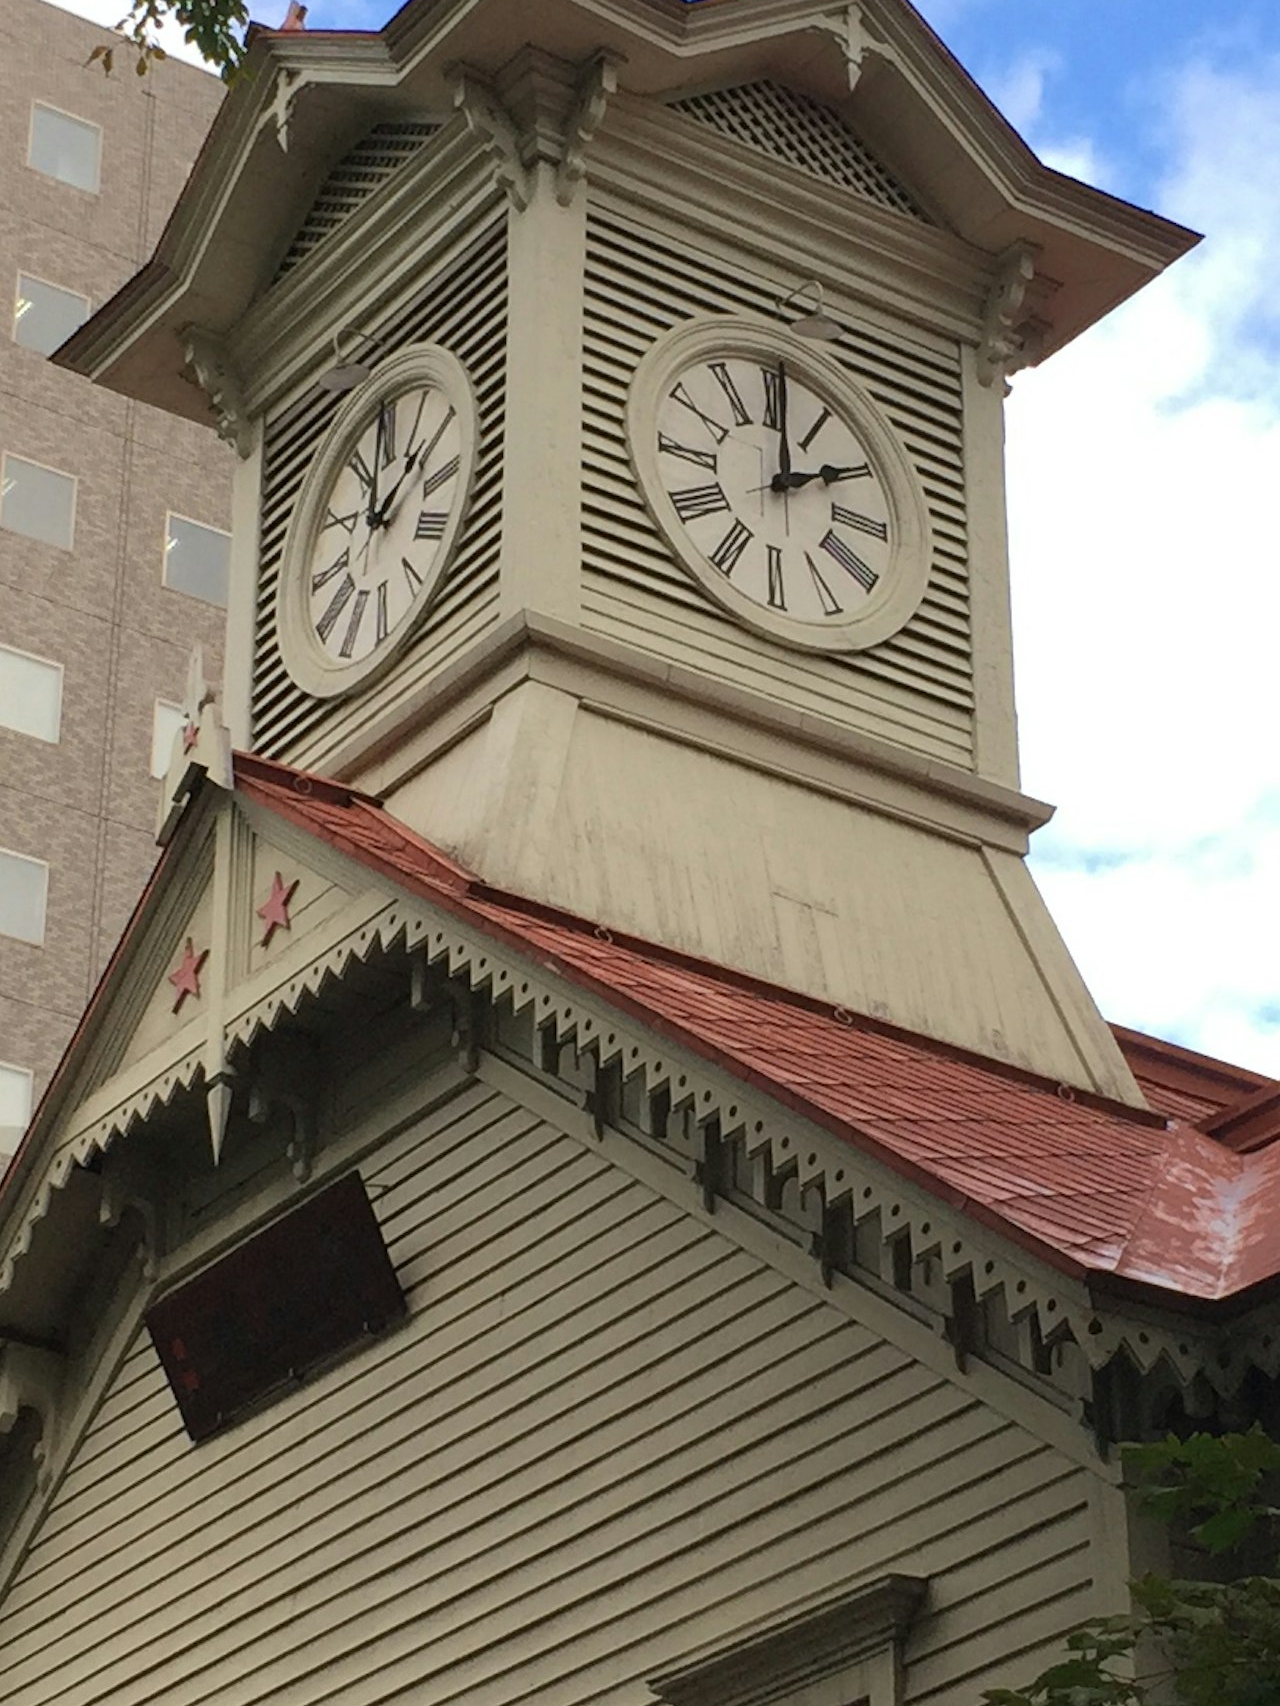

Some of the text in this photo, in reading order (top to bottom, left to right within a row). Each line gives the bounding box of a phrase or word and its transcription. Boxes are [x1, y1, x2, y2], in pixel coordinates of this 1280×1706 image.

[669, 381, 729, 445] X
[707, 363, 753, 426] XI
[404, 390, 429, 458] I
[419, 405, 456, 472] II
[797, 406, 832, 453] I
[423, 454, 460, 501] III
[658, 431, 718, 475] IX
[321, 508, 359, 534] X
[413, 510, 449, 541] IIII
[667, 481, 731, 525] VIII
[831, 502, 887, 543] III
[708, 517, 754, 579] VII
[818, 528, 879, 595] IIII
[402, 557, 424, 599] V
[766, 544, 788, 612] VI
[803, 550, 844, 616] V
